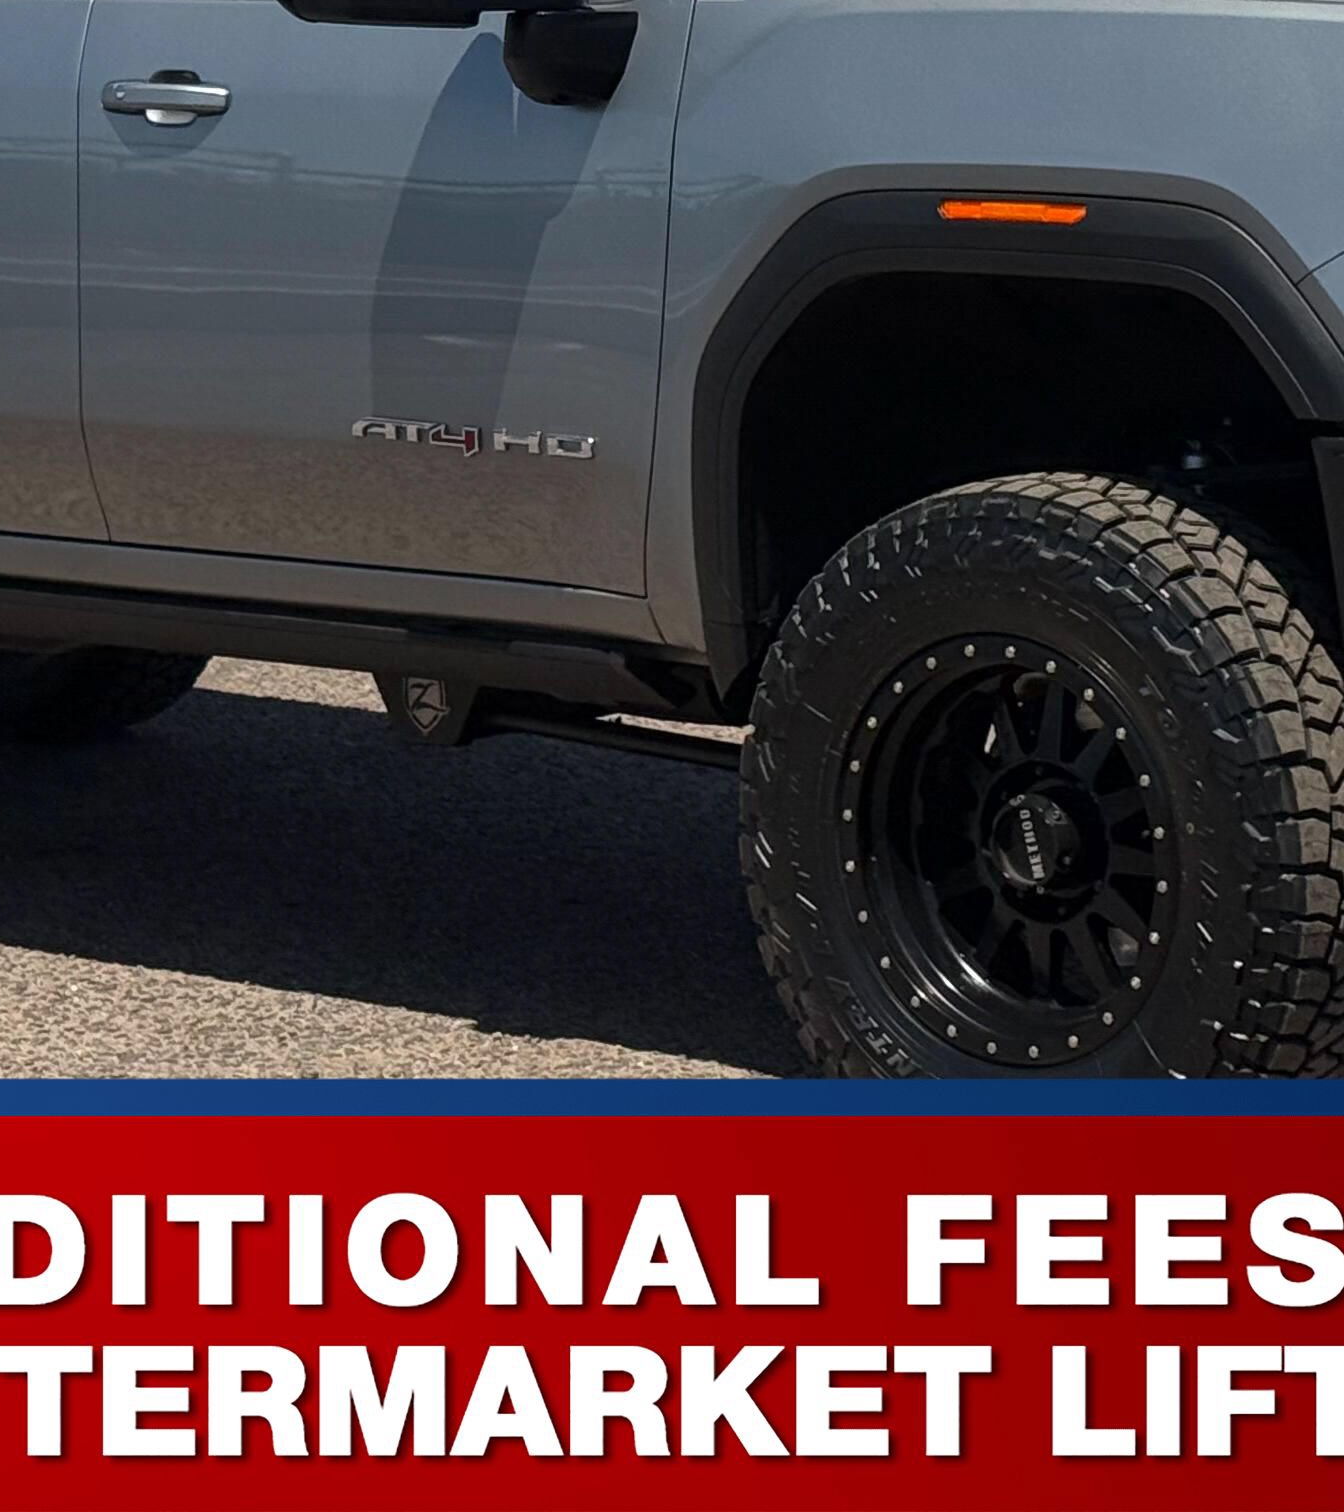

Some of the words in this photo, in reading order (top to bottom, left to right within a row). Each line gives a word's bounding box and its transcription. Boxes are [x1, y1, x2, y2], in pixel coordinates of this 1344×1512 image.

[352, 416, 480, 456] AT4
[493, 429, 594, 458] HD
[1018, 808, 1047, 880] METHOD
